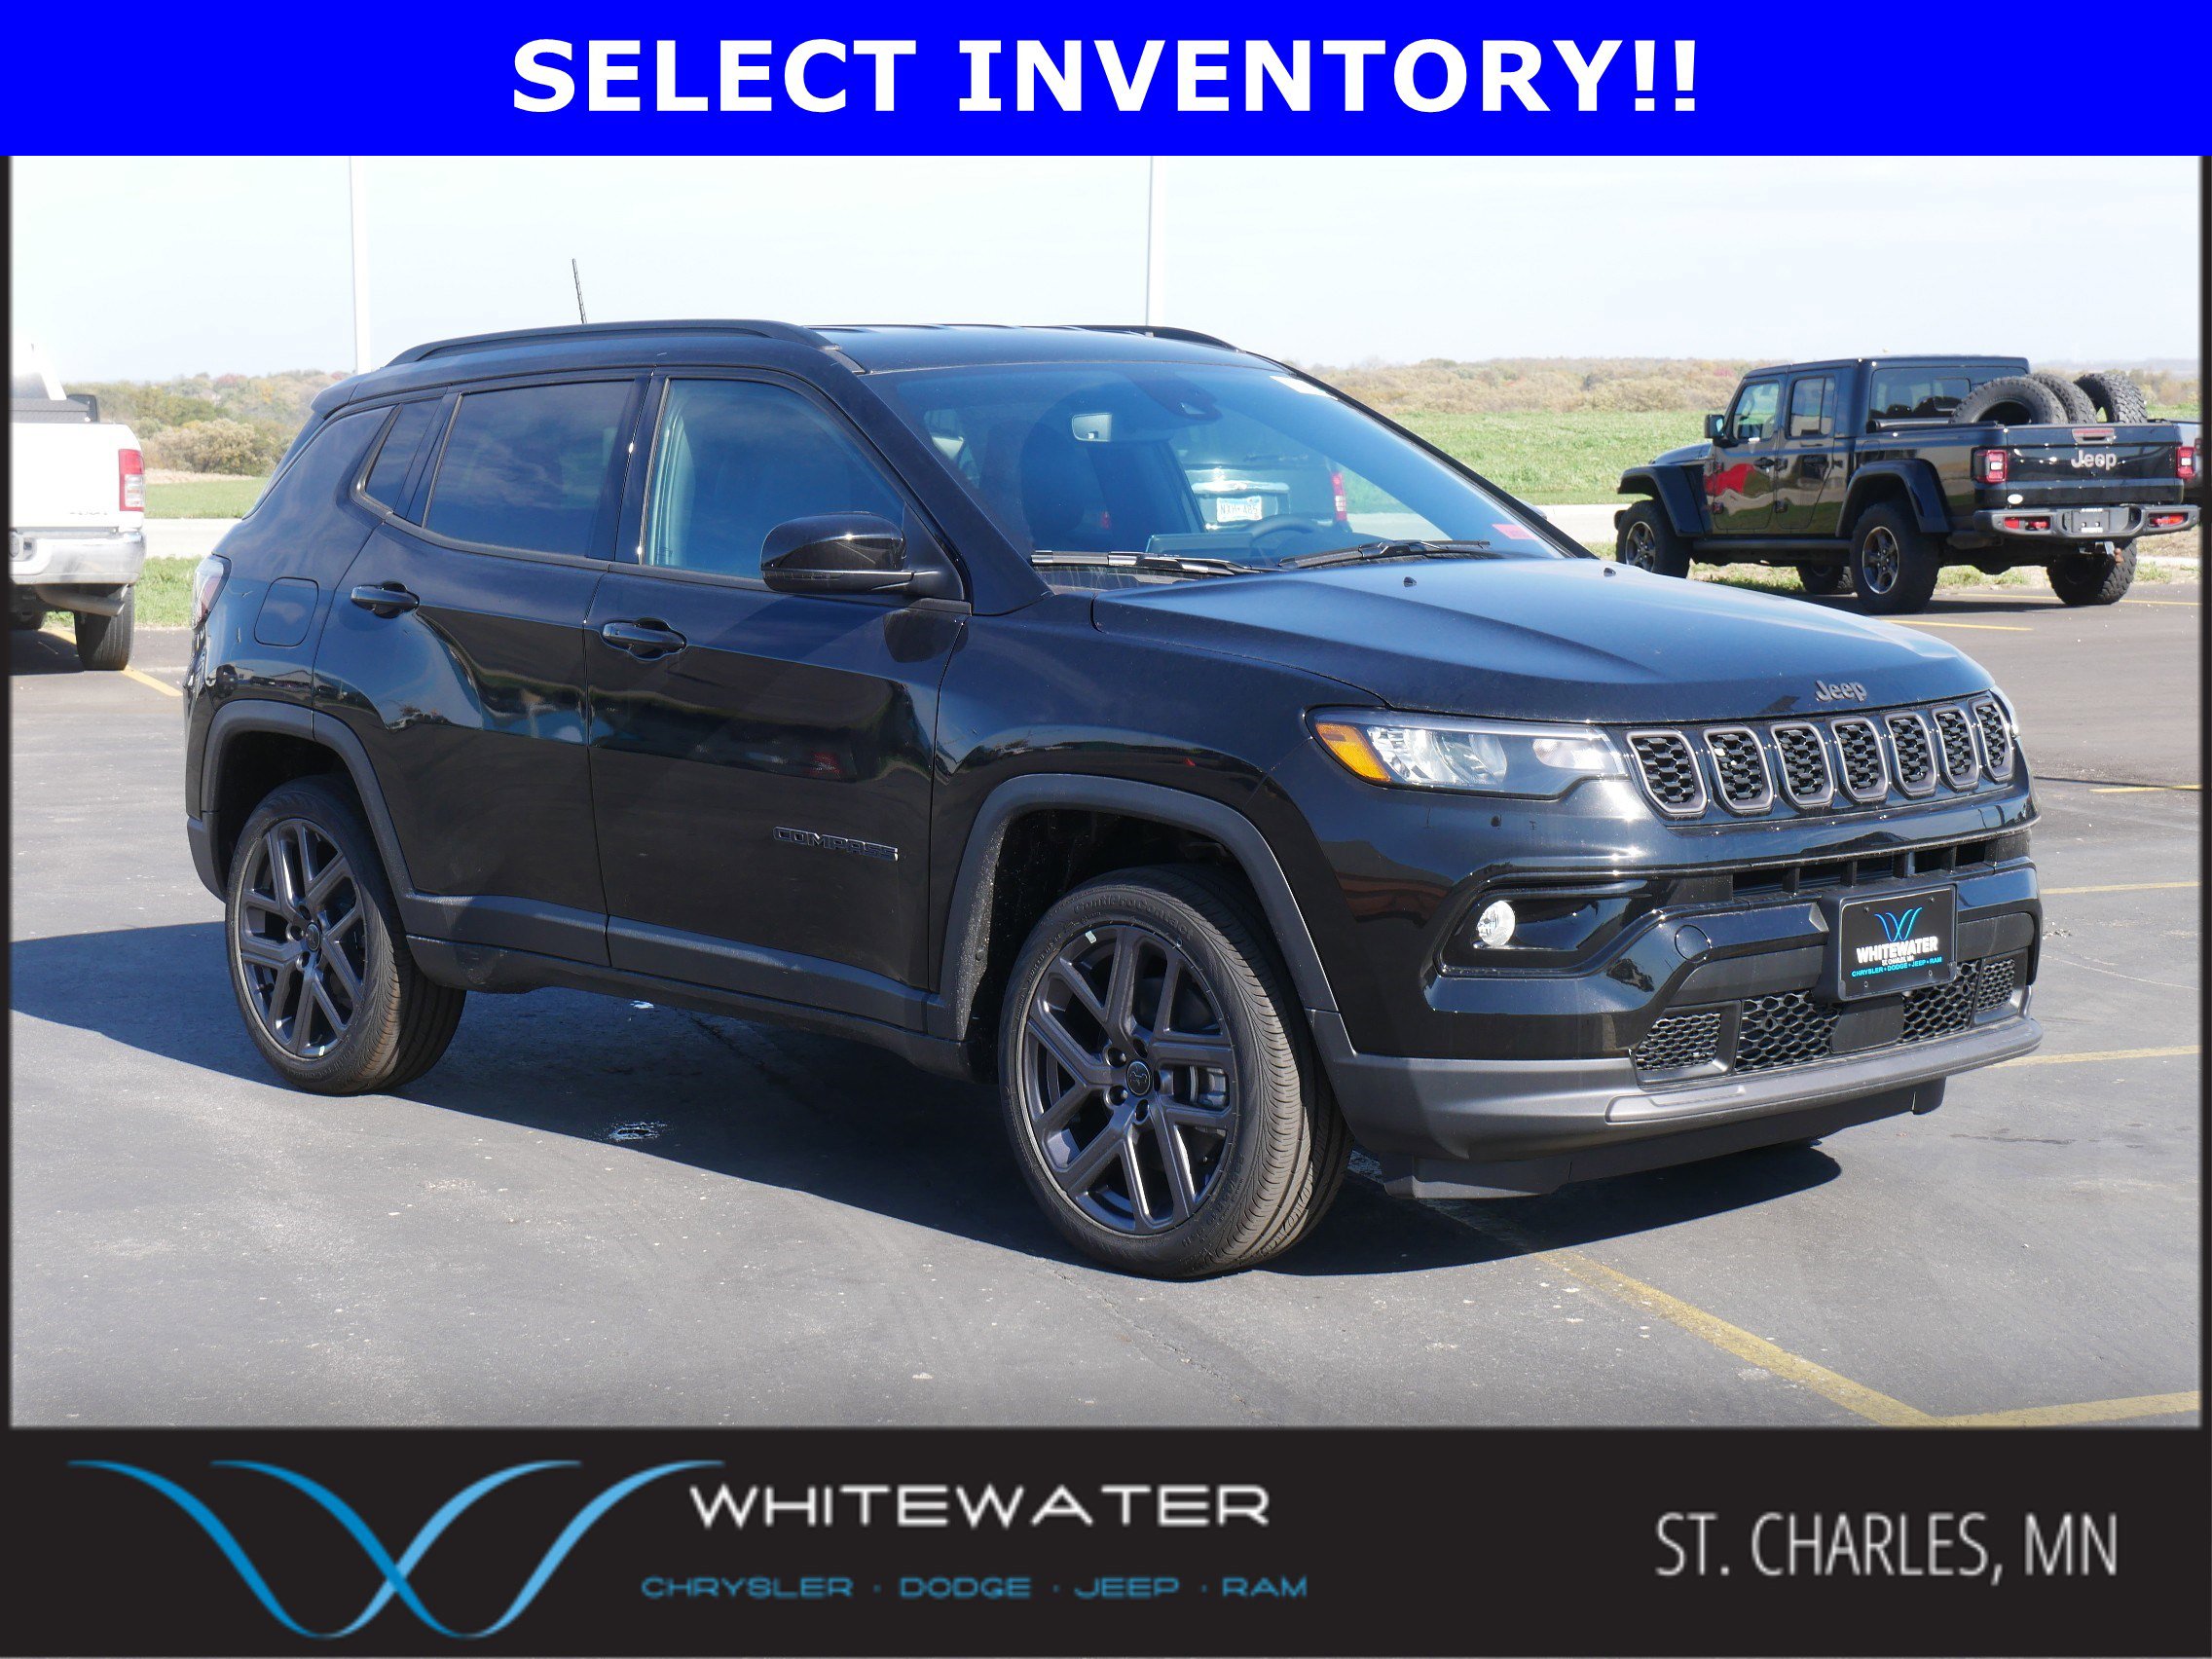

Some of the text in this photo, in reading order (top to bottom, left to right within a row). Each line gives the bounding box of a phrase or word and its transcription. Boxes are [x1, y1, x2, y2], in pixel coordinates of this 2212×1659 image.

[2071, 450, 2118, 471] Jeep
[1815, 680, 1867, 702] Jeep
[772, 826, 899, 862] COMPASS
[1856, 936, 1938, 963] WHITEWATER
[1851, 966, 1884, 977] CHRYSLER
[1887, 962, 1908, 972] DODGE
[1911, 959, 1926, 968] JEEP
